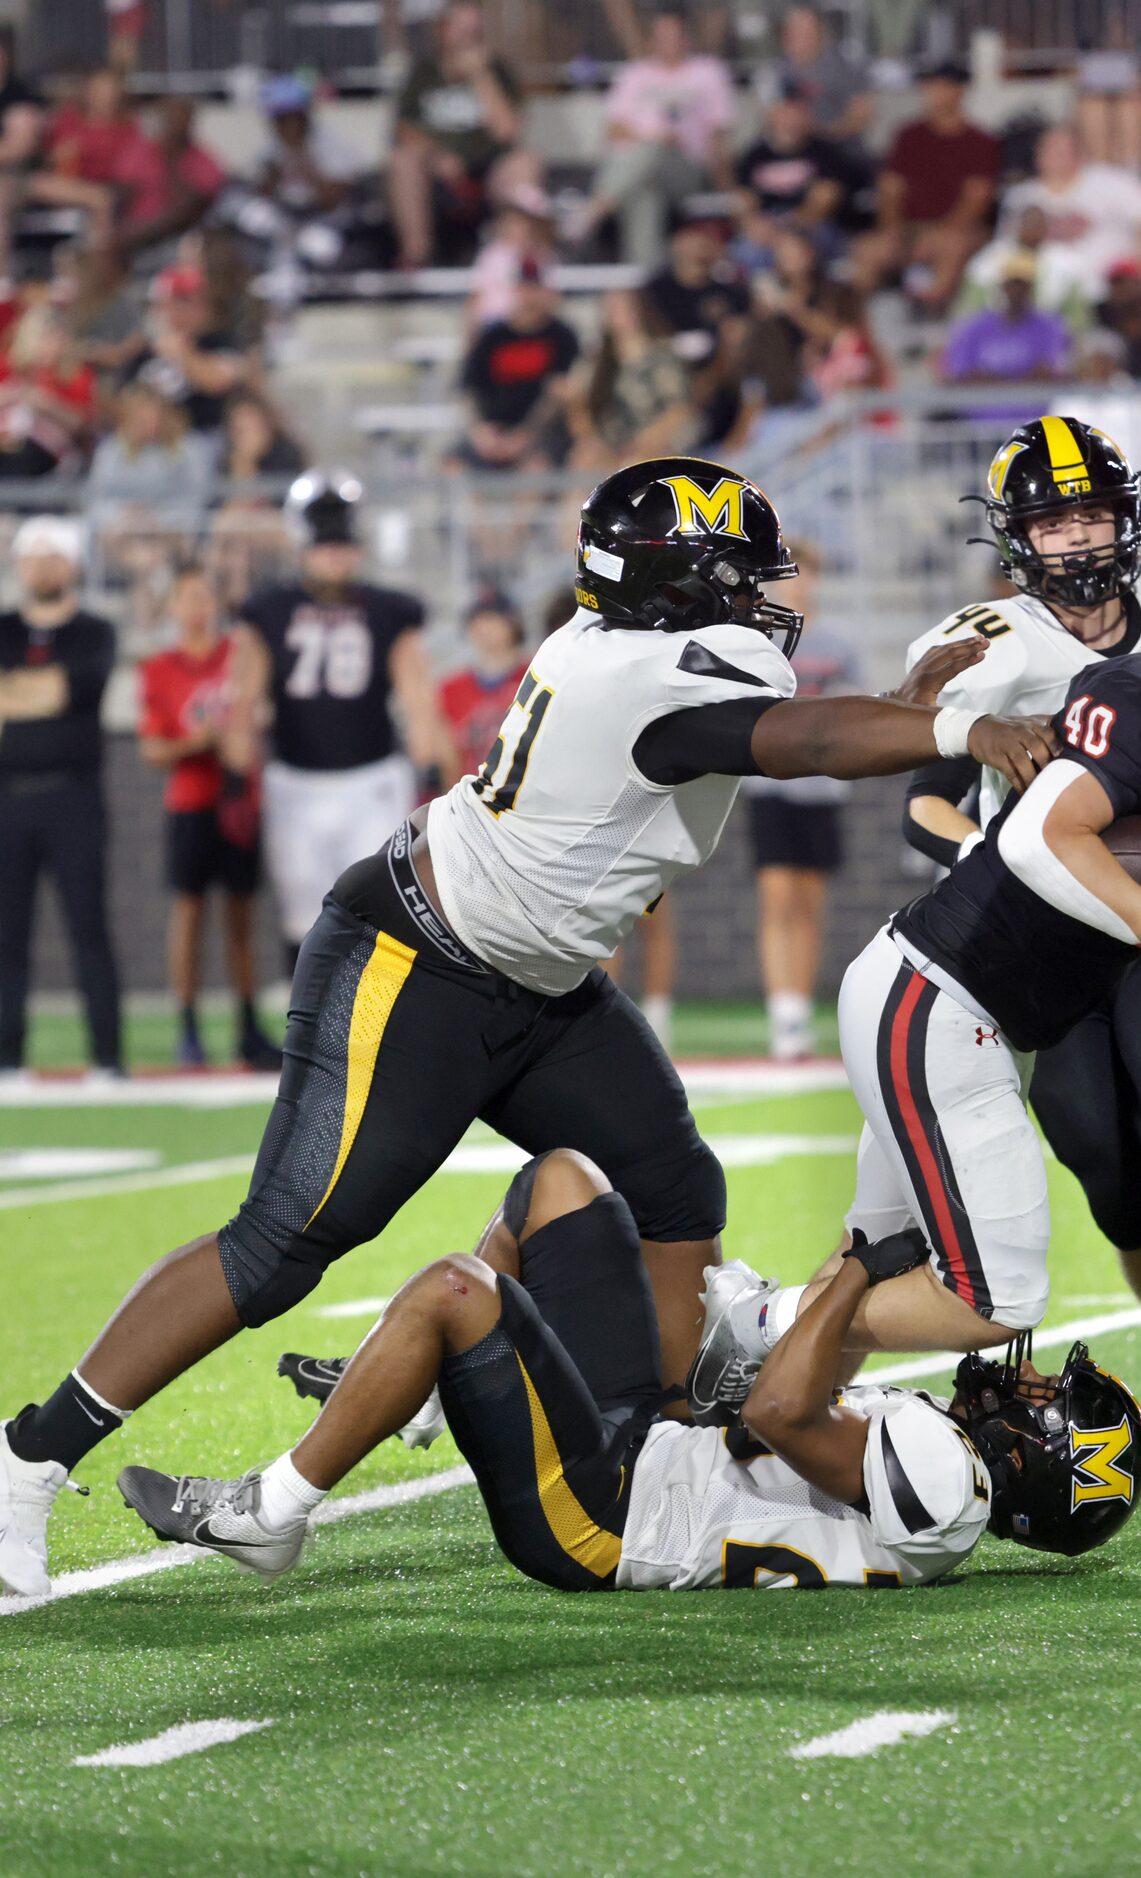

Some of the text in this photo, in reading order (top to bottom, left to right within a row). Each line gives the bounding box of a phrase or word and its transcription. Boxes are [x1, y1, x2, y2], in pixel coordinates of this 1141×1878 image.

[655, 475, 752, 543] M
[1057, 479, 1092, 497] WTB
[943, 604, 1015, 641] 44
[1064, 693, 1117, 760] 40
[1069, 1413, 1135, 1514] M
